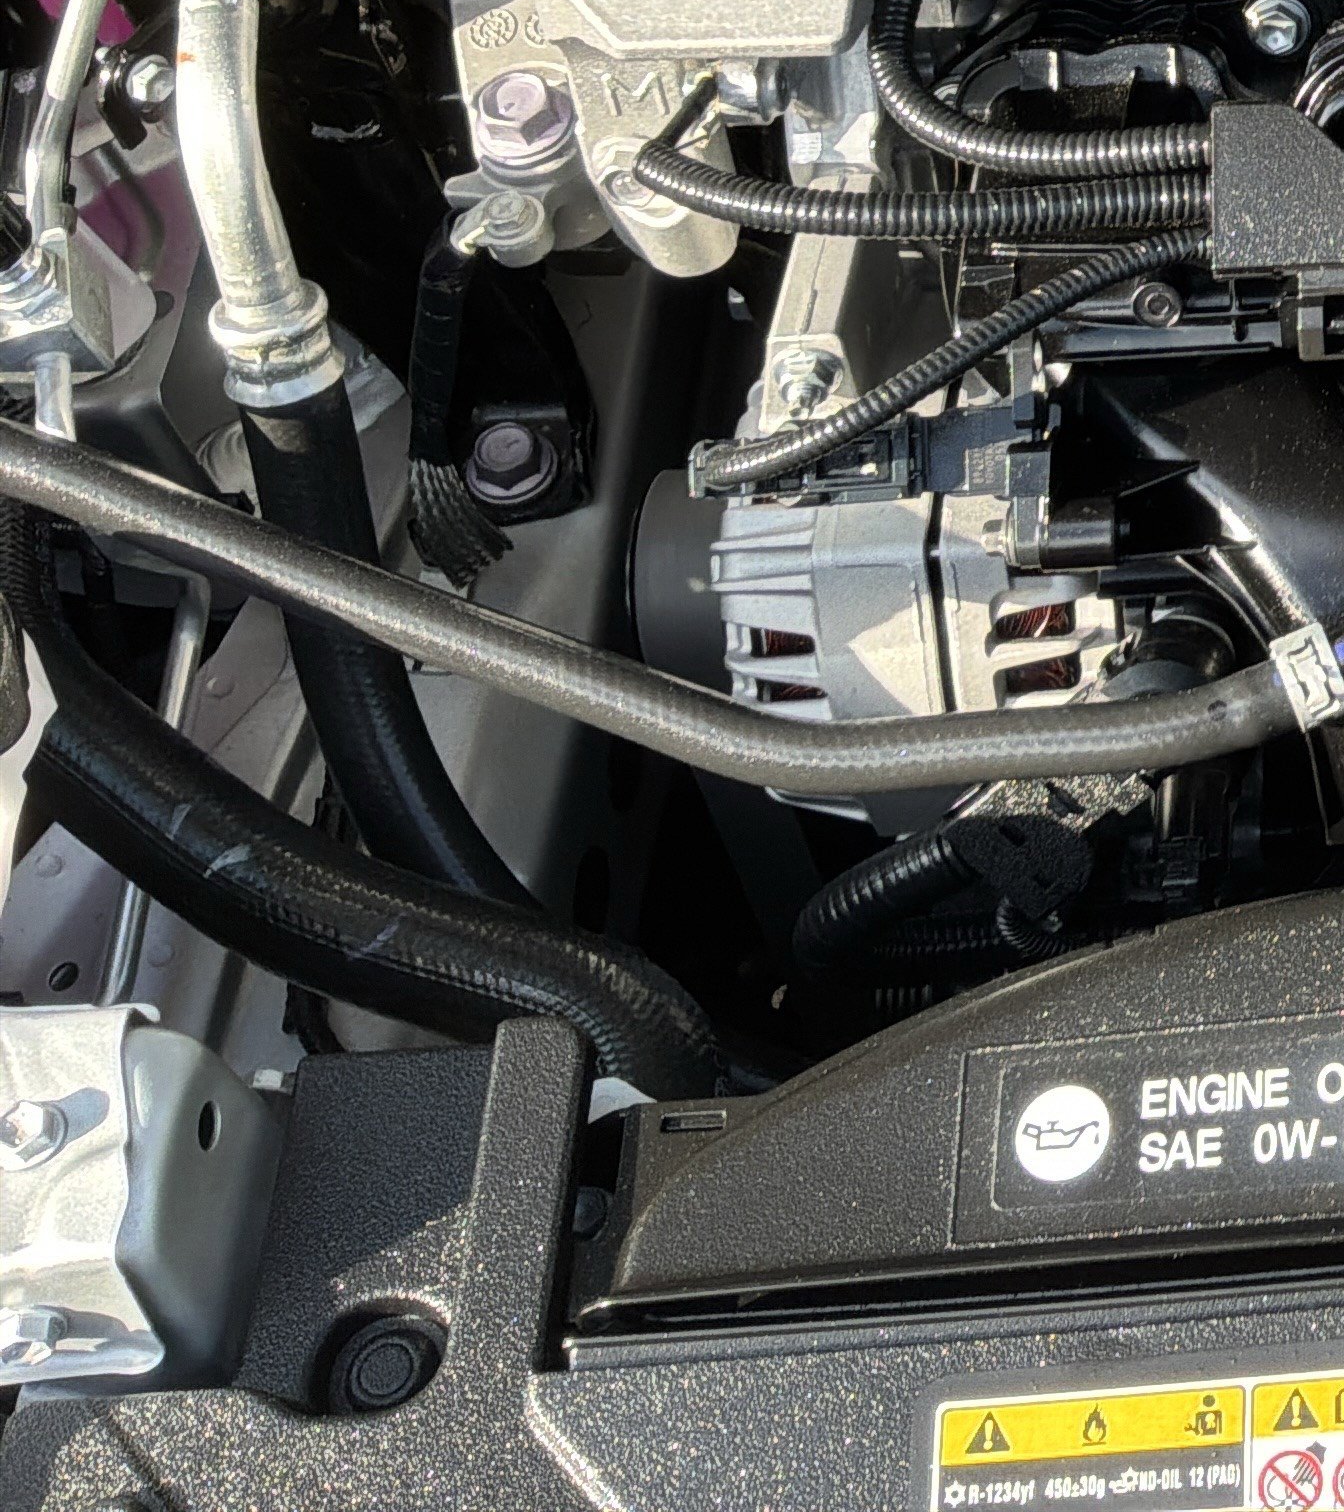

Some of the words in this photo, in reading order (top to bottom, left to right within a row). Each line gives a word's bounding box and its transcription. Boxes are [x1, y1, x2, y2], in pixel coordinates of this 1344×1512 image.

[1140, 1068, 1290, 1119] ENGINE
[1139, 1127, 1223, 1173] SAE
[1044, 1475, 1106, 1499] 450±30g
[1189, 1467, 1204, 1488] 12
